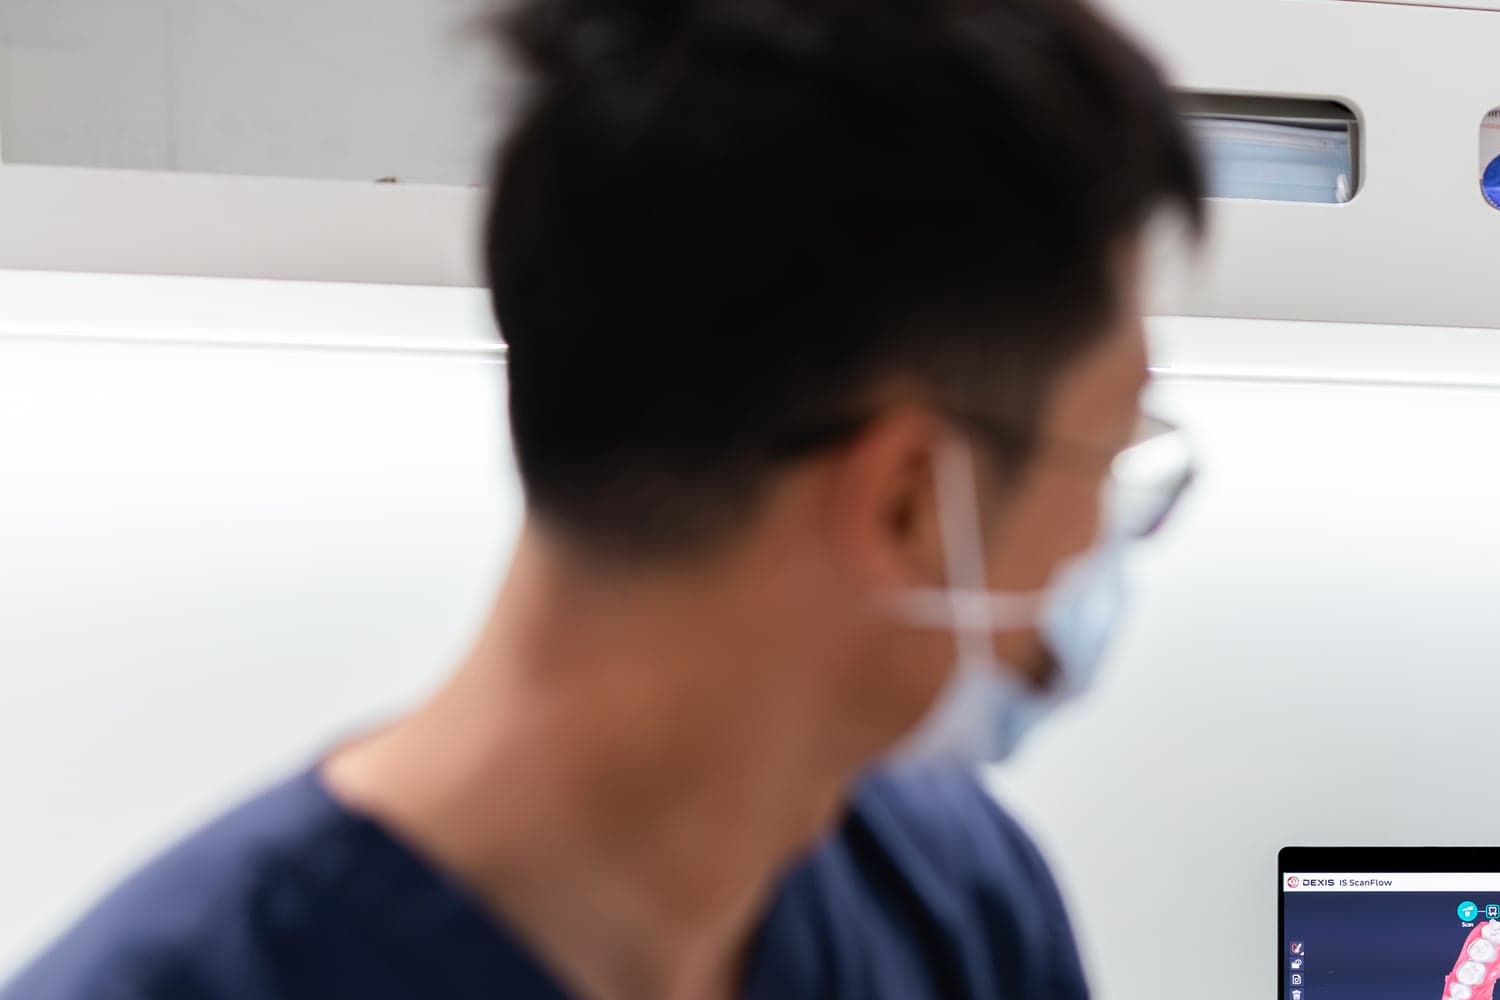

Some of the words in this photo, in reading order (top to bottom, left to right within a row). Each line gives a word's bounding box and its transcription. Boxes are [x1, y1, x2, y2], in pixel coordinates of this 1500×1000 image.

[1303, 879, 1335, 887] DEXIS
[1339, 879, 1348, 887] IS
[1349, 879, 1393, 887] ScanFlow
